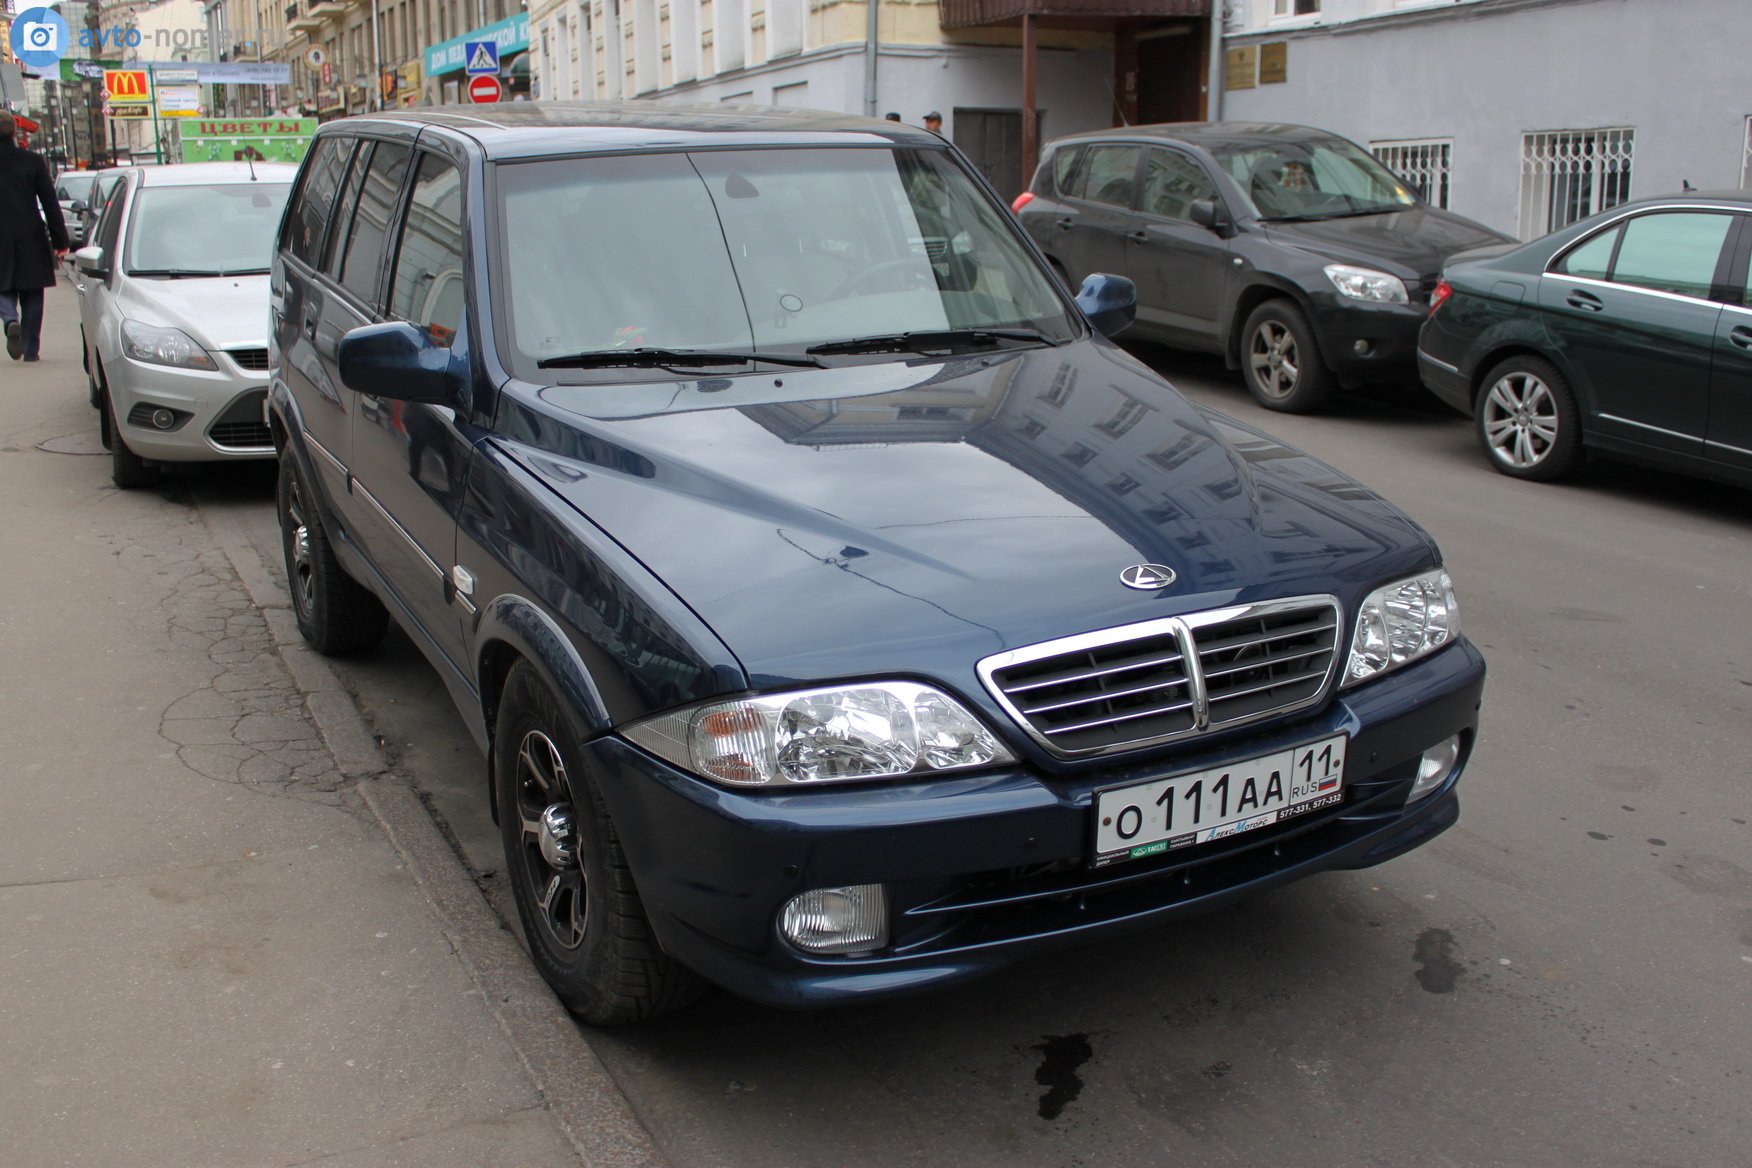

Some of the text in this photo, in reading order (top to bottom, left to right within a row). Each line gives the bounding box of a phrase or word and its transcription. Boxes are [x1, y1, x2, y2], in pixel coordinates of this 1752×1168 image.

[431, 49, 447, 72] ДОМ
[199, 121, 300, 135] ЦВЕТЫ
[1299, 744, 1333, 782] 11
[1292, 782, 1318, 798] RUS
[1313, 793, 1342, 809] 577-332
